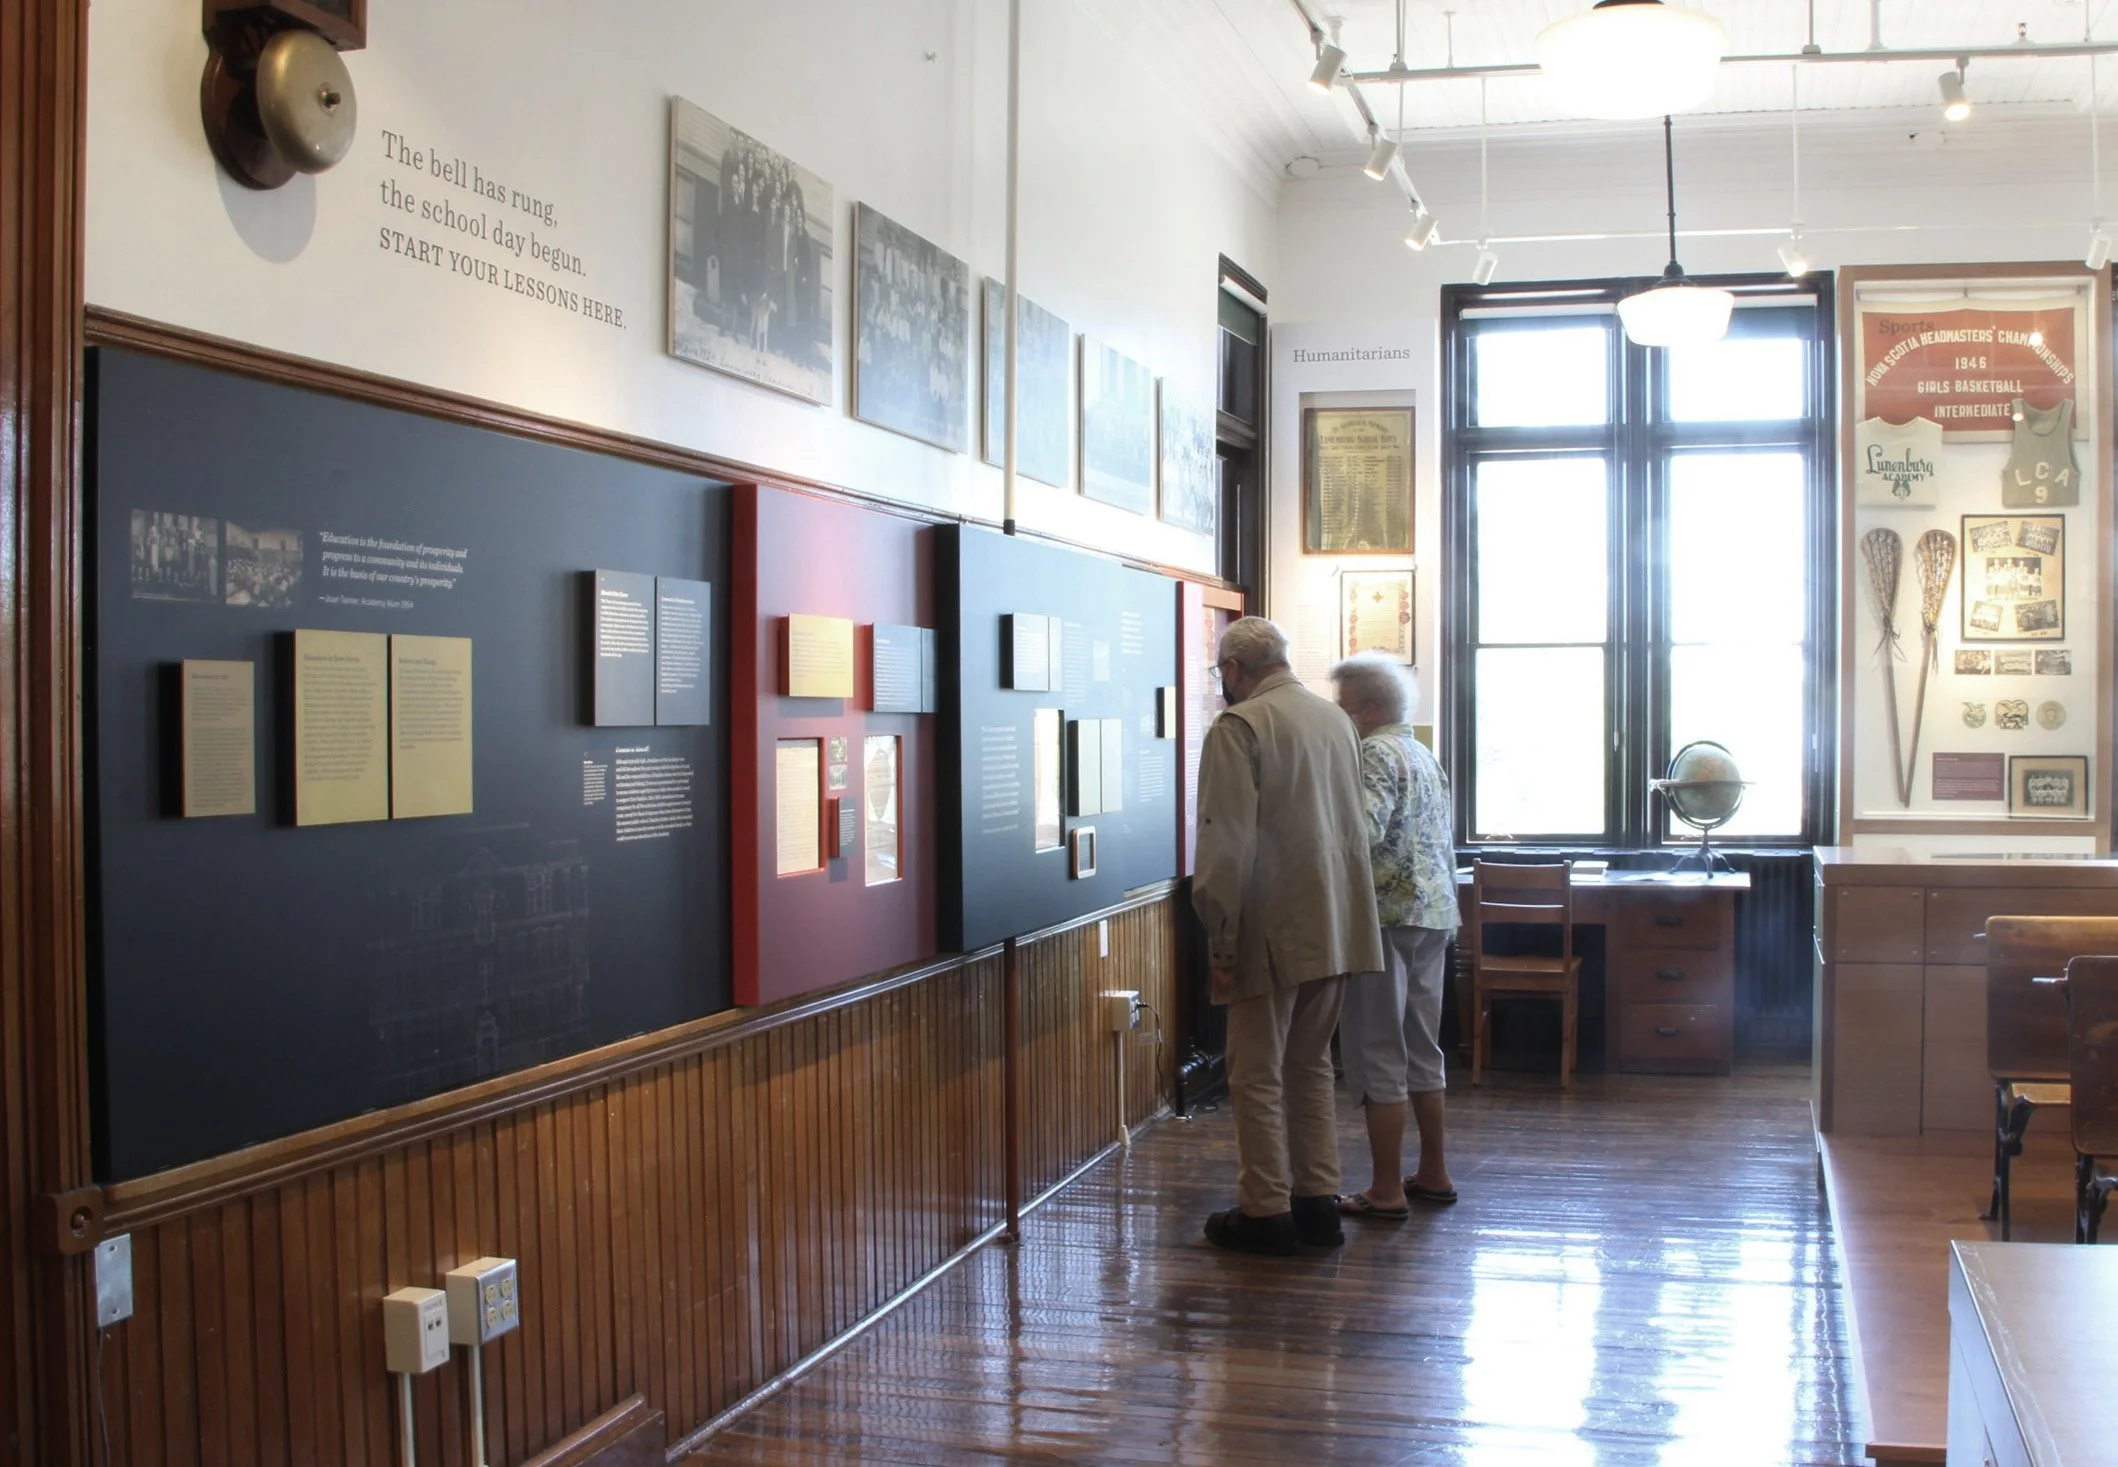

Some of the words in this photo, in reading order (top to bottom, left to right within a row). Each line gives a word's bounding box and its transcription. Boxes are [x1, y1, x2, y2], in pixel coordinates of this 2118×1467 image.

[382, 129, 424, 170] The
[430, 148, 468, 189] bell
[473, 166, 506, 203] has
[511, 190, 558, 228] rung,
[380, 179, 415, 213] the
[421, 199, 487, 240] school
[493, 220, 526, 257] day
[531, 232, 587, 277] begun.
[379, 227, 443, 267] START
[449, 250, 499, 286] YOUR
[503, 269, 579, 312] LESSONS
[582, 296, 627, 329] HERE.
[1879, 319, 1934, 336] Sports
[1293, 346, 1410, 363] Humanitarians
[1866, 361, 1890, 386] NOVA
[1884, 336, 1920, 366] SCOTIA
[1998, 329, 2074, 385] CHAMONSHIPS
[1955, 356, 1987, 370] 1946
[1917, 380, 1950, 394] GIRLS
[1955, 379, 2024, 393] BASKETBALL
[1934, 403, 2011, 418] INTERMEDIATE
[1865, 443, 1934, 477] Lunenburg
[1882, 473, 1925, 481] ACADEMY
[2034, 486, 2048, 504] 9
